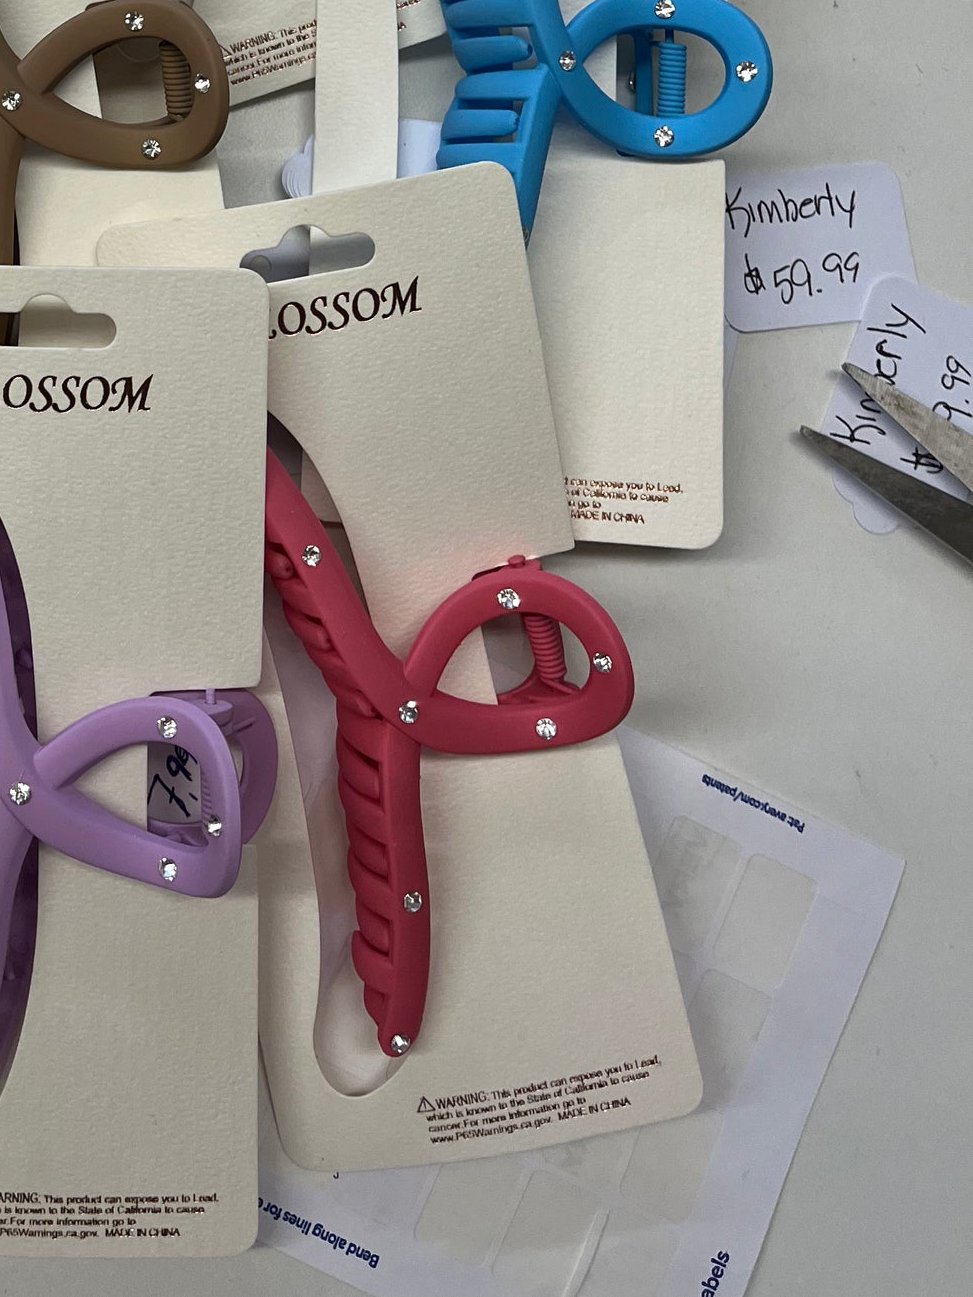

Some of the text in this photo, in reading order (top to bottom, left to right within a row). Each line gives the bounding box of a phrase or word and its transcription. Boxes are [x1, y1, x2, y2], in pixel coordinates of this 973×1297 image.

[726, 183, 855, 238] Kimberly
[269, 276, 421, 338] OSSOM
[626, 482, 644, 492] you
[646, 482, 655, 491] to
[629, 492, 638, 500] to
[570, 509, 645, 524] MADE IN CHINA
[592, 501, 601, 509] to
[702, 774, 805, 833] Pat: avery.com/patents
[426, 1071, 649, 1122] which is known to the State of California to cause
[435, 1091, 489, 1109] WARNING:
[491, 1089, 511, 1100] This
[514, 1081, 548, 1097] product
[551, 1077, 567, 1088] can
[569, 1070, 603, 1084] expose
[605, 1065, 621, 1078] you
[624, 1062, 633, 1071] to
[482, 1114, 506, 1125] more
[508, 1102, 560, 1120] information
[562, 1099, 575, 1110] go
[557, 1107, 587, 1121] MADE
[589, 1104, 599, 1114] IN
[600, 1097, 631, 1112] CHINA
[5, 1206, 12, 1214] is
[15, 1206, 46, 1214] known
[49, 1206, 57, 1214] to
[60, 1206, 75, 1214] the
[78, 1206, 102, 1214] State
[105, 1205, 114, 1214] of
[117, 1205, 162, 1214] California
[164, 1205, 174, 1214] to
[176, 1206, 205, 1214] cause
[44, 1194, 63, 1203] This
[67, 1194, 101, 1205] product
[125, 1196, 159, 1205] expose
[162, 1195, 178, 1205] you
[181, 1194, 190, 1203] to
[264, 1202, 282, 1220] for
[29, 1218, 53, 1226] more
[56, 1217, 109, 1226] information
[112, 1218, 124, 1227] go
[105, 1228, 135, 1237] MADE
[137, 1228, 147, 1237] IN
[149, 1228, 181, 1237] CHINA
[283, 1211, 312, 1235] lines
[312, 1223, 348, 1249] along
[346, 1243, 380, 1268] Bend
[702, 1251, 730, 1297] abels
